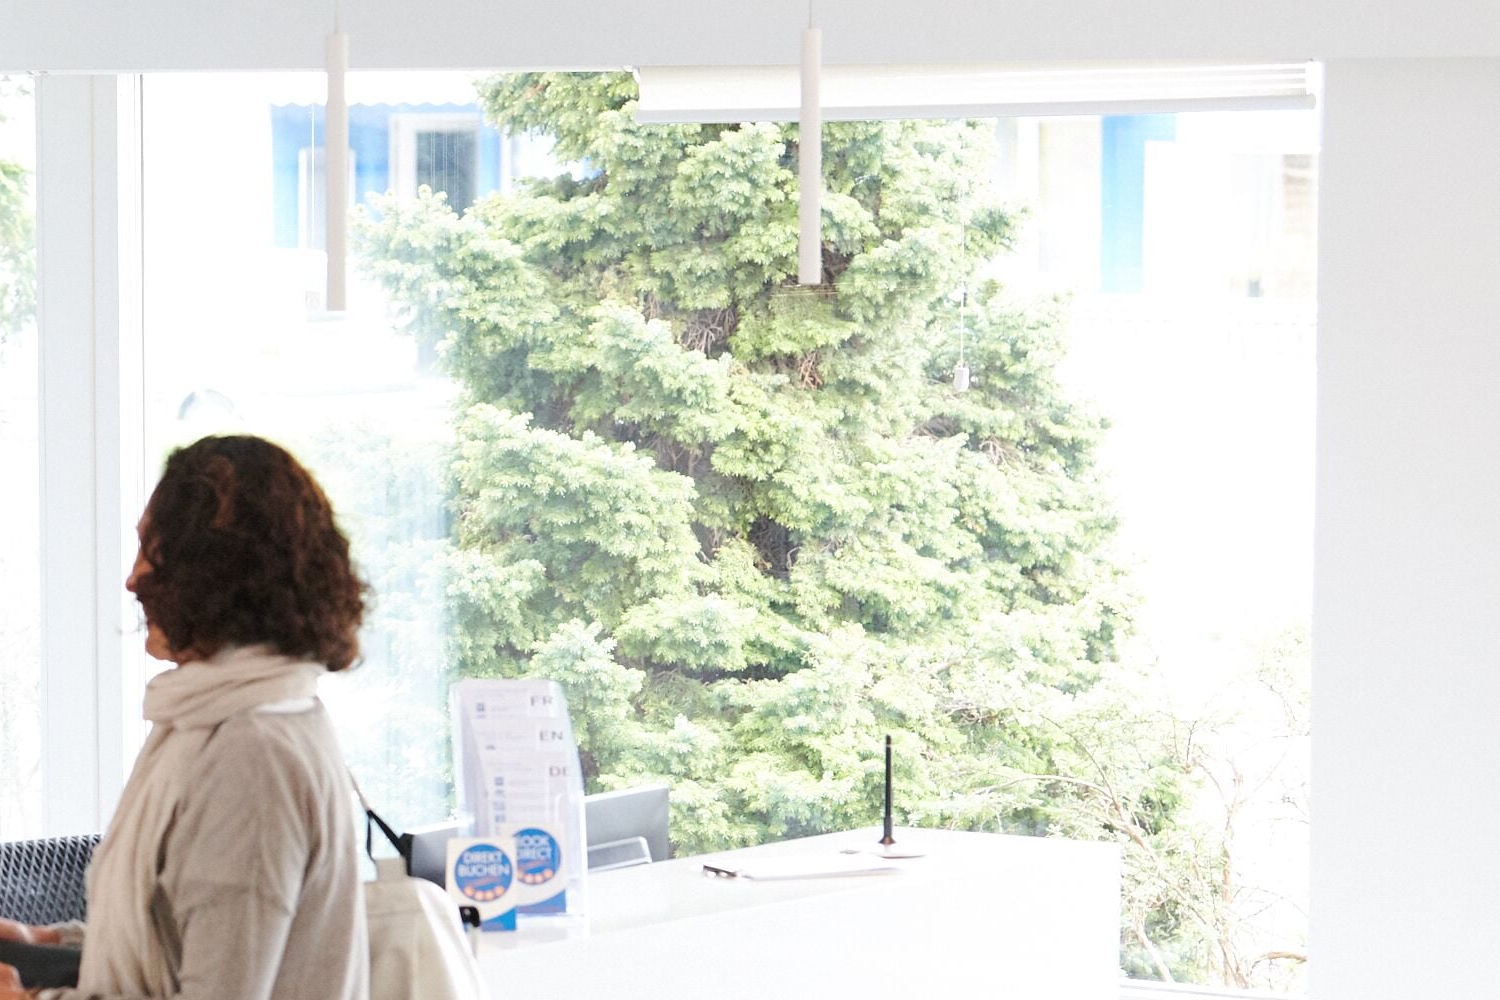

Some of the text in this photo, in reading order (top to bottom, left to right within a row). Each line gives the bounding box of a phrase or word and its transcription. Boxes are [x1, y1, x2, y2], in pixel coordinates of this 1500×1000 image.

[530, 695, 554, 707] FR
[539, 730, 564, 741] EN
[463, 850, 502, 864] DIREKT
[457, 863, 510, 877] BUCHEN
